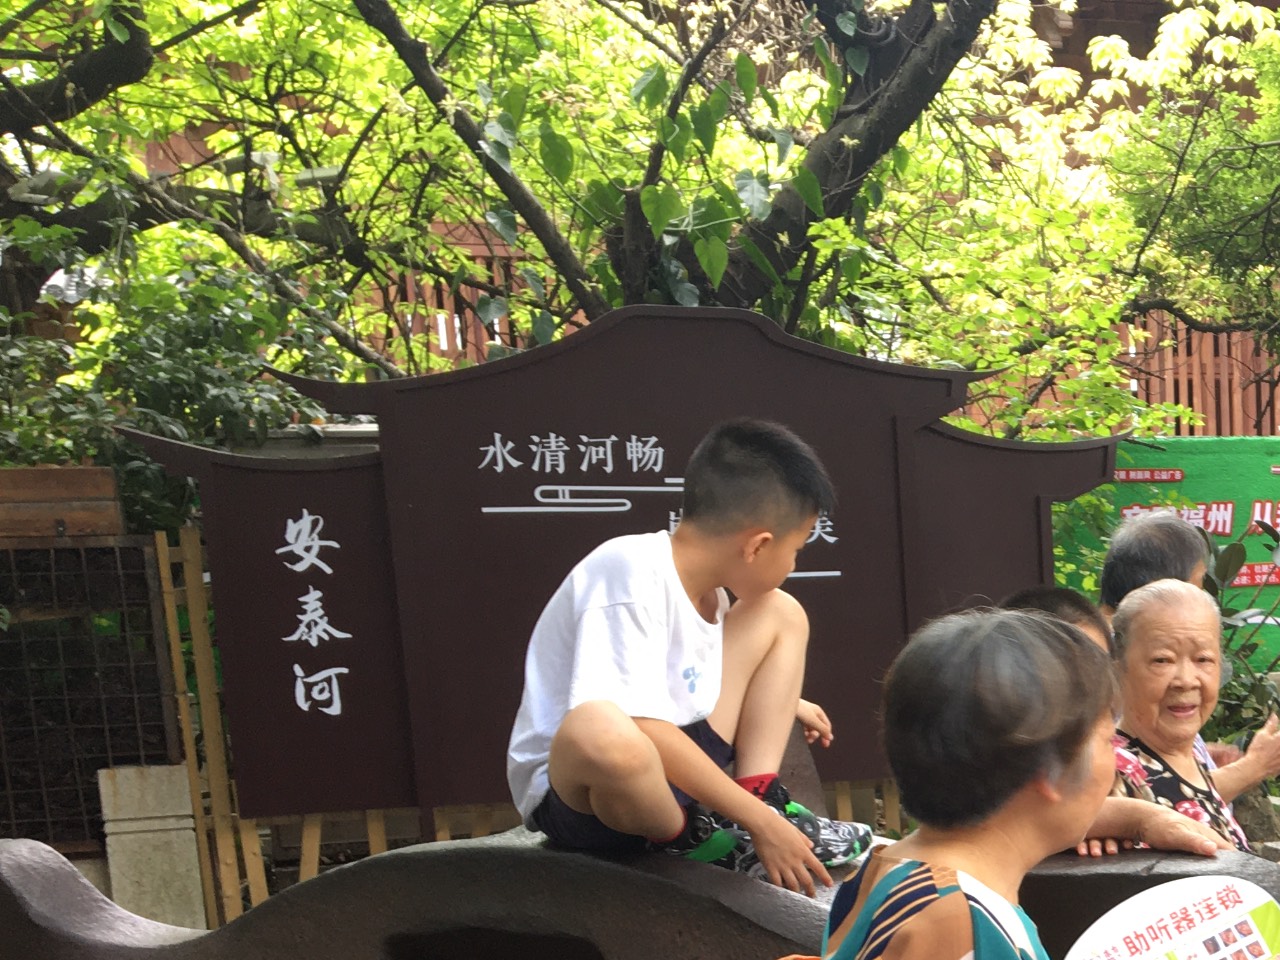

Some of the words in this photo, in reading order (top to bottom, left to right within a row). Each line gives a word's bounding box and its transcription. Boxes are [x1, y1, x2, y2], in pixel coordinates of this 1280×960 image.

[478, 432, 665, 474] 水清河畅
[275, 508, 352, 715] 安泰河
[1122, 884, 1244, 957] 助听器连锁
